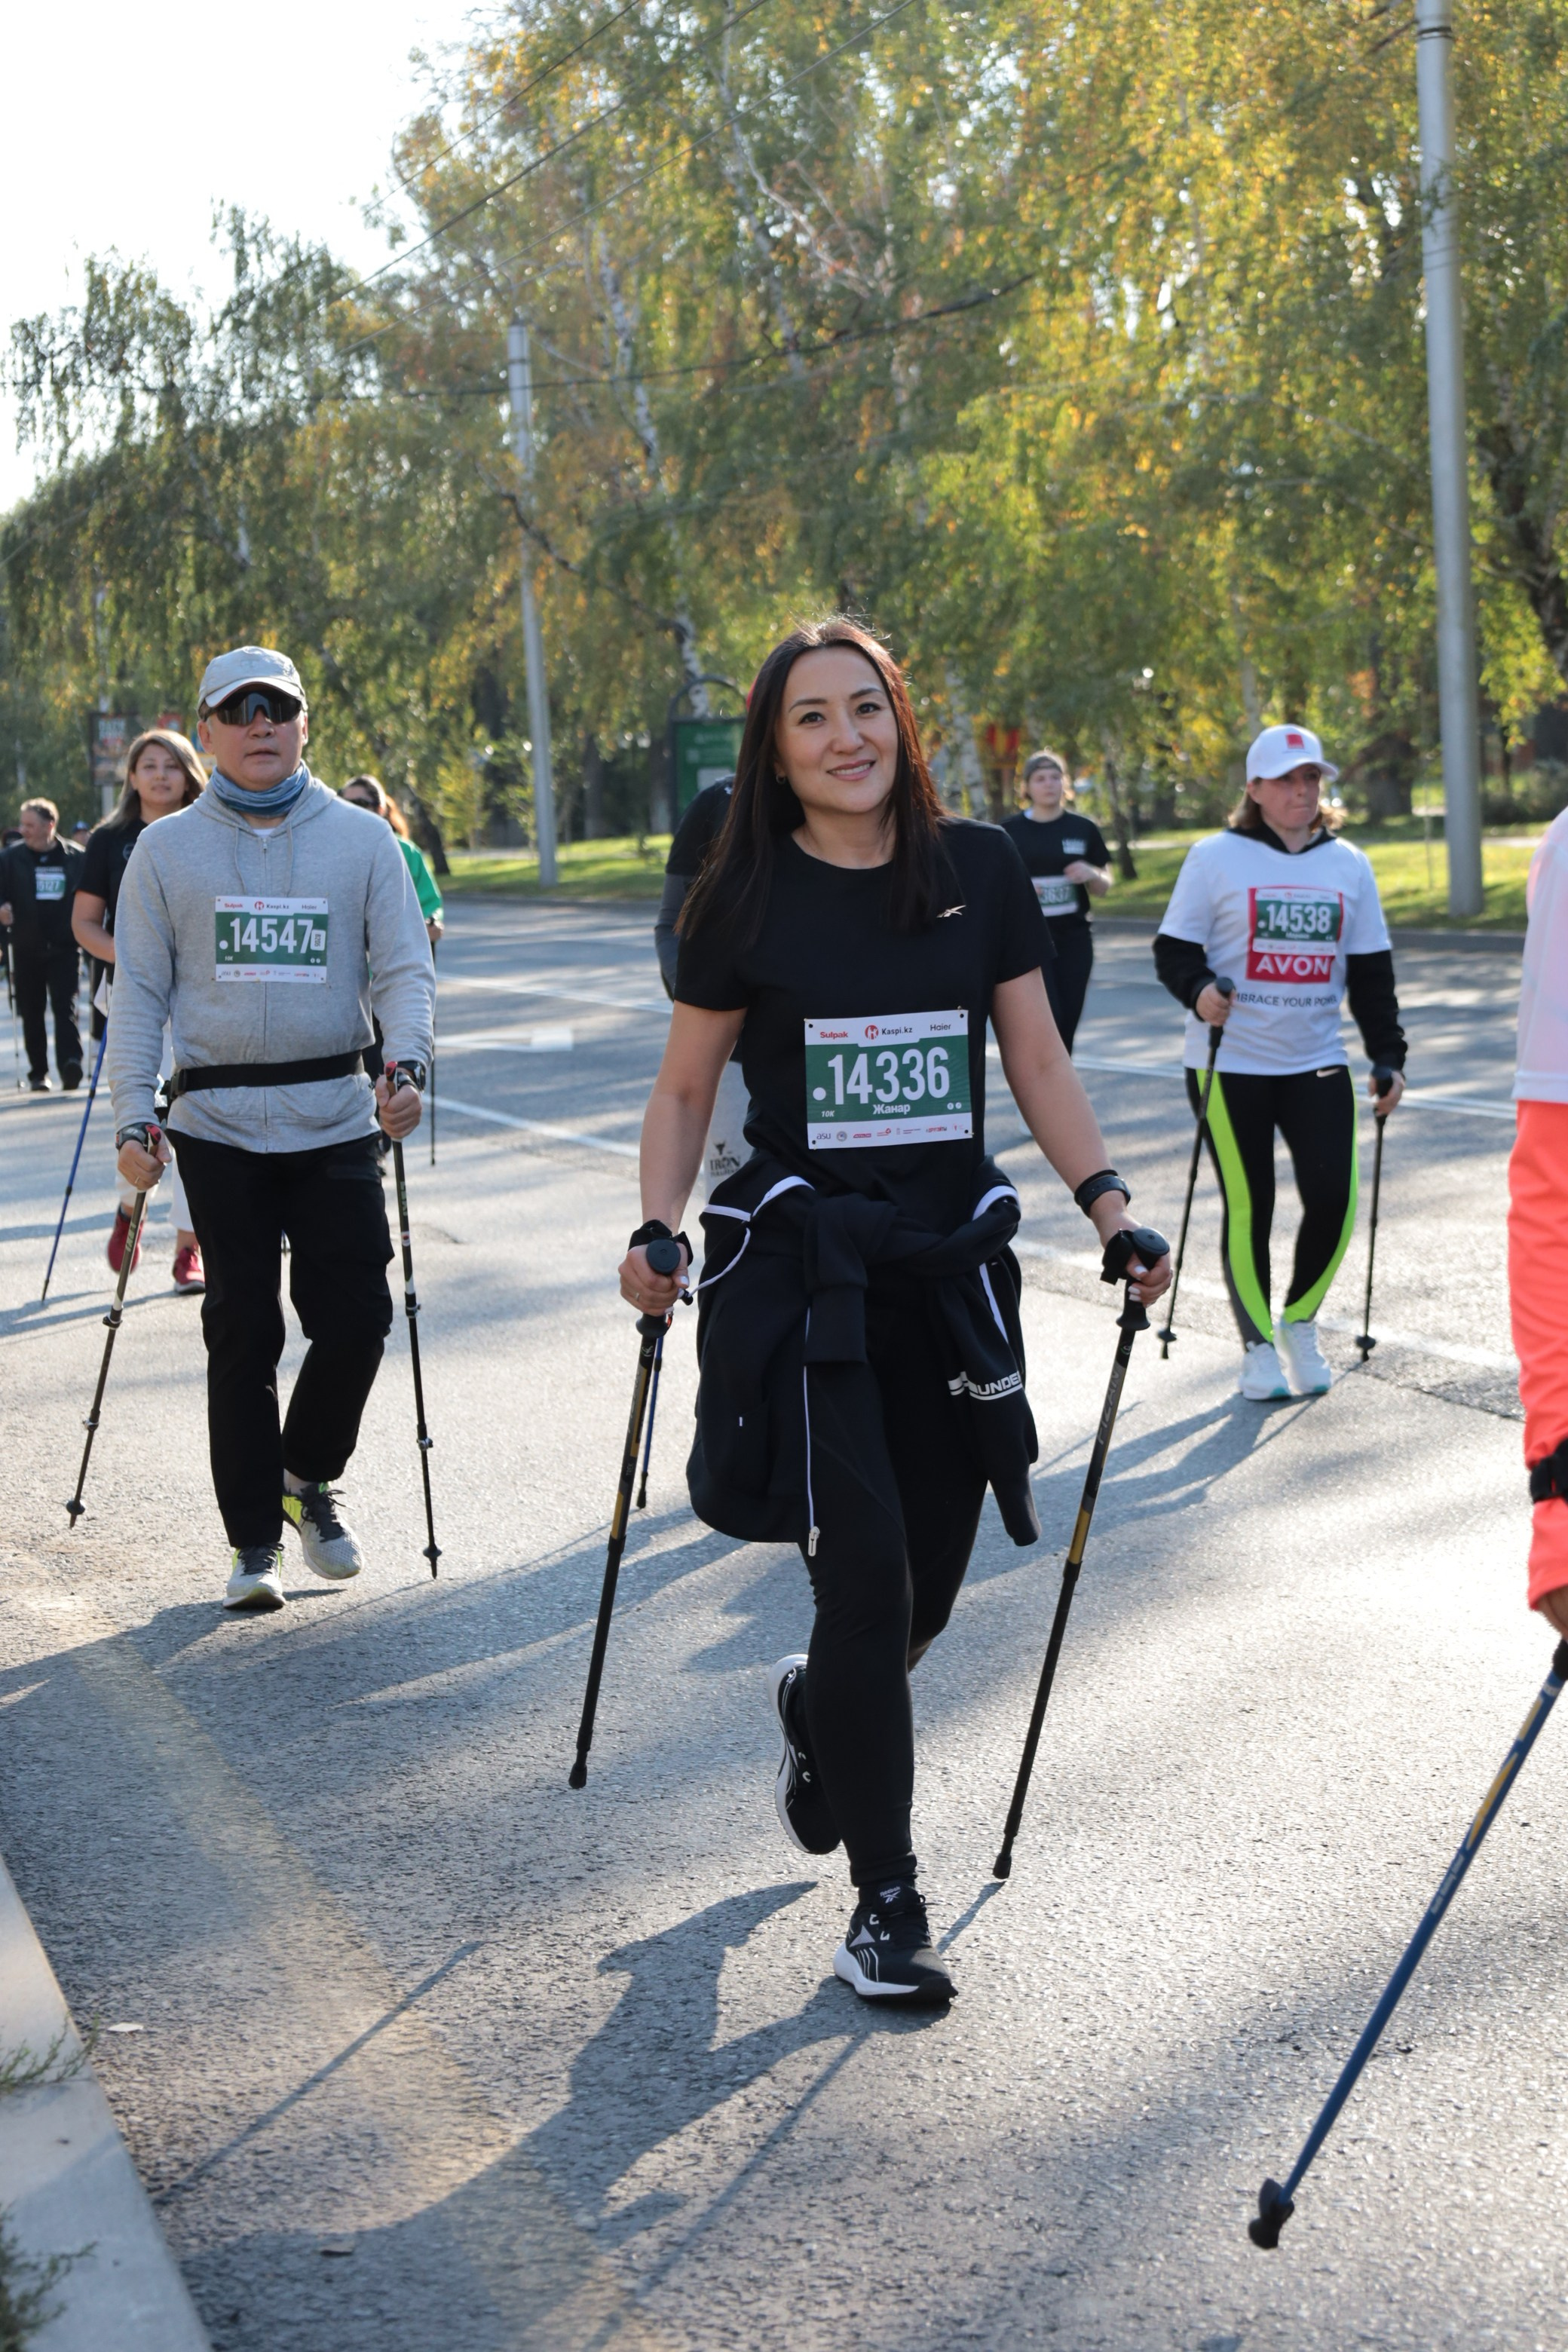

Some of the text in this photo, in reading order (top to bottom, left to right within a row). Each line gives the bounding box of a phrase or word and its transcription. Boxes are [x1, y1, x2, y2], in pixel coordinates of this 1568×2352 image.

[1266, 904, 1331, 933] 14538
[230, 917, 314, 954] 14547
[1255, 954, 1329, 976] AVON
[1282, 997, 1312, 1007] YOUR
[819, 1031, 849, 1040] Sulpak
[881, 1026, 913, 1036] Kaspi.kz
[828, 1046, 950, 1105] 14336
[872, 1104, 911, 1115] Жанар
[880, 1886, 901, 1897] Reebok
